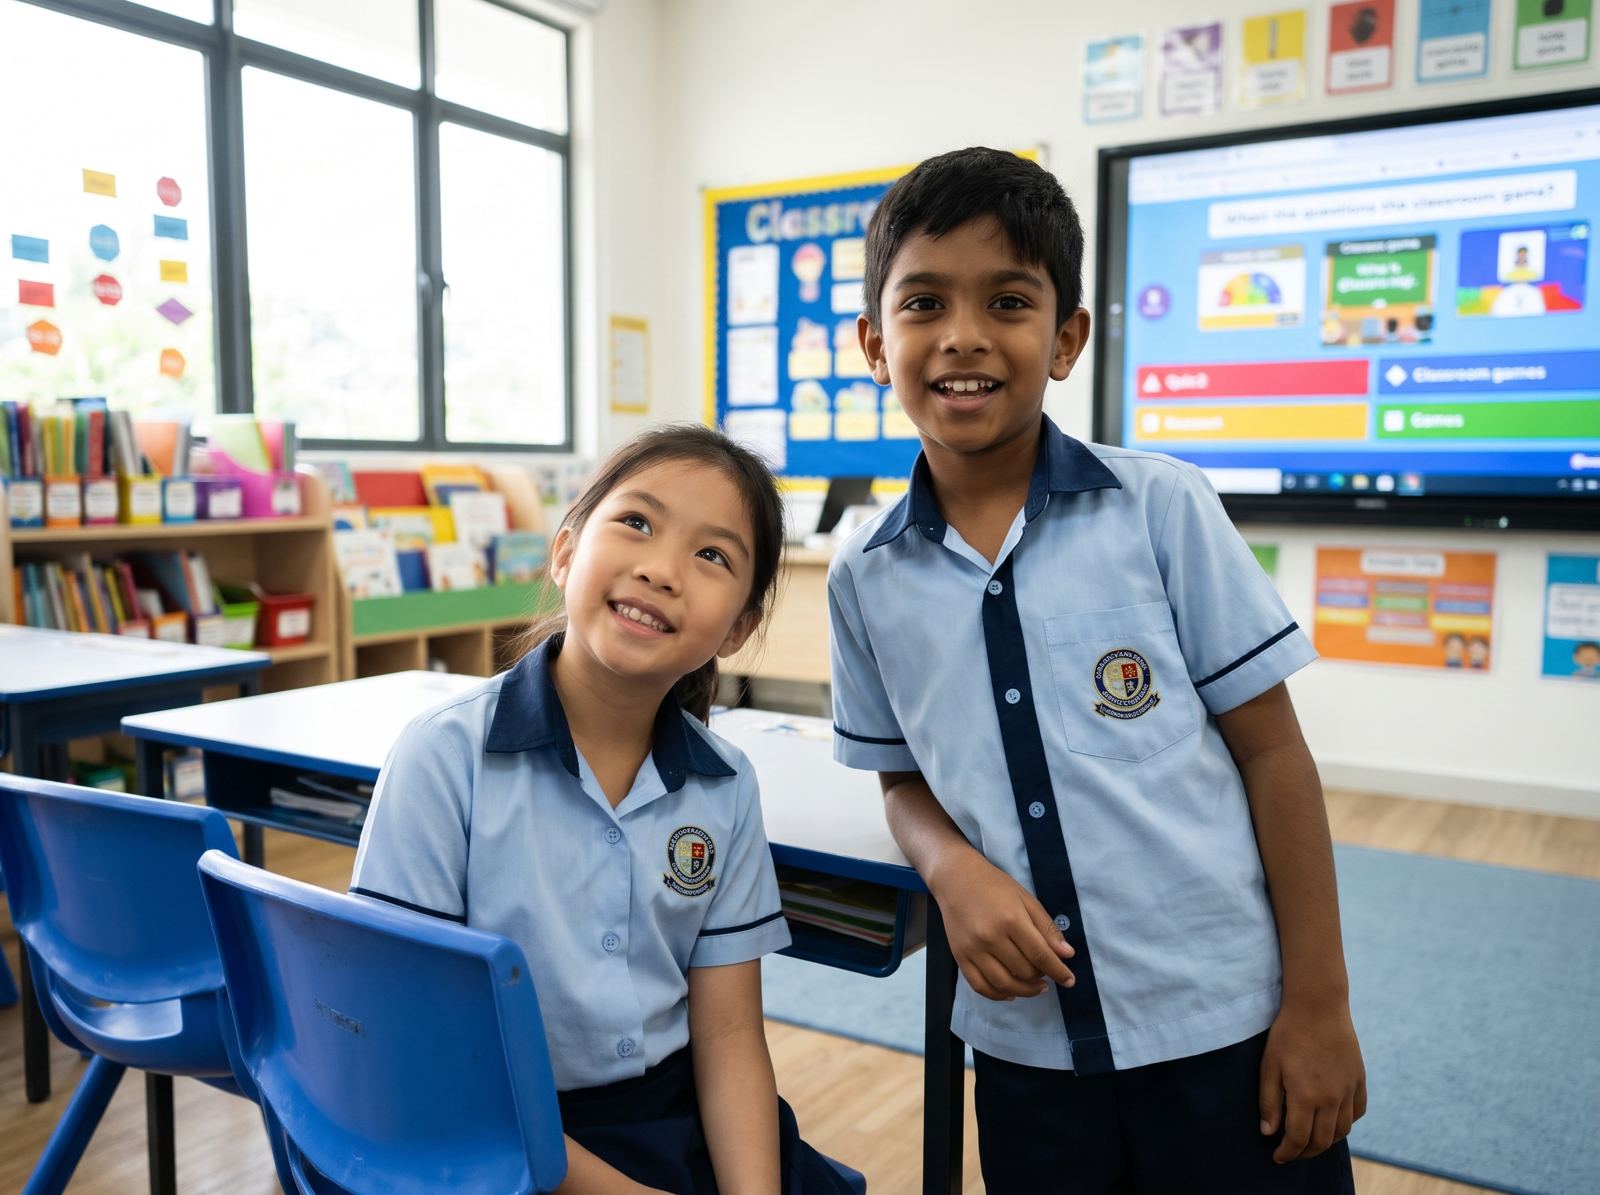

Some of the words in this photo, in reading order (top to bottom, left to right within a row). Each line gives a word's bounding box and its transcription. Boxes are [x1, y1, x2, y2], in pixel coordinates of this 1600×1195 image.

[1412, 366, 1491, 383] Classroom
[1491, 365, 1547, 384] games
[1410, 411, 1464, 429] Games
